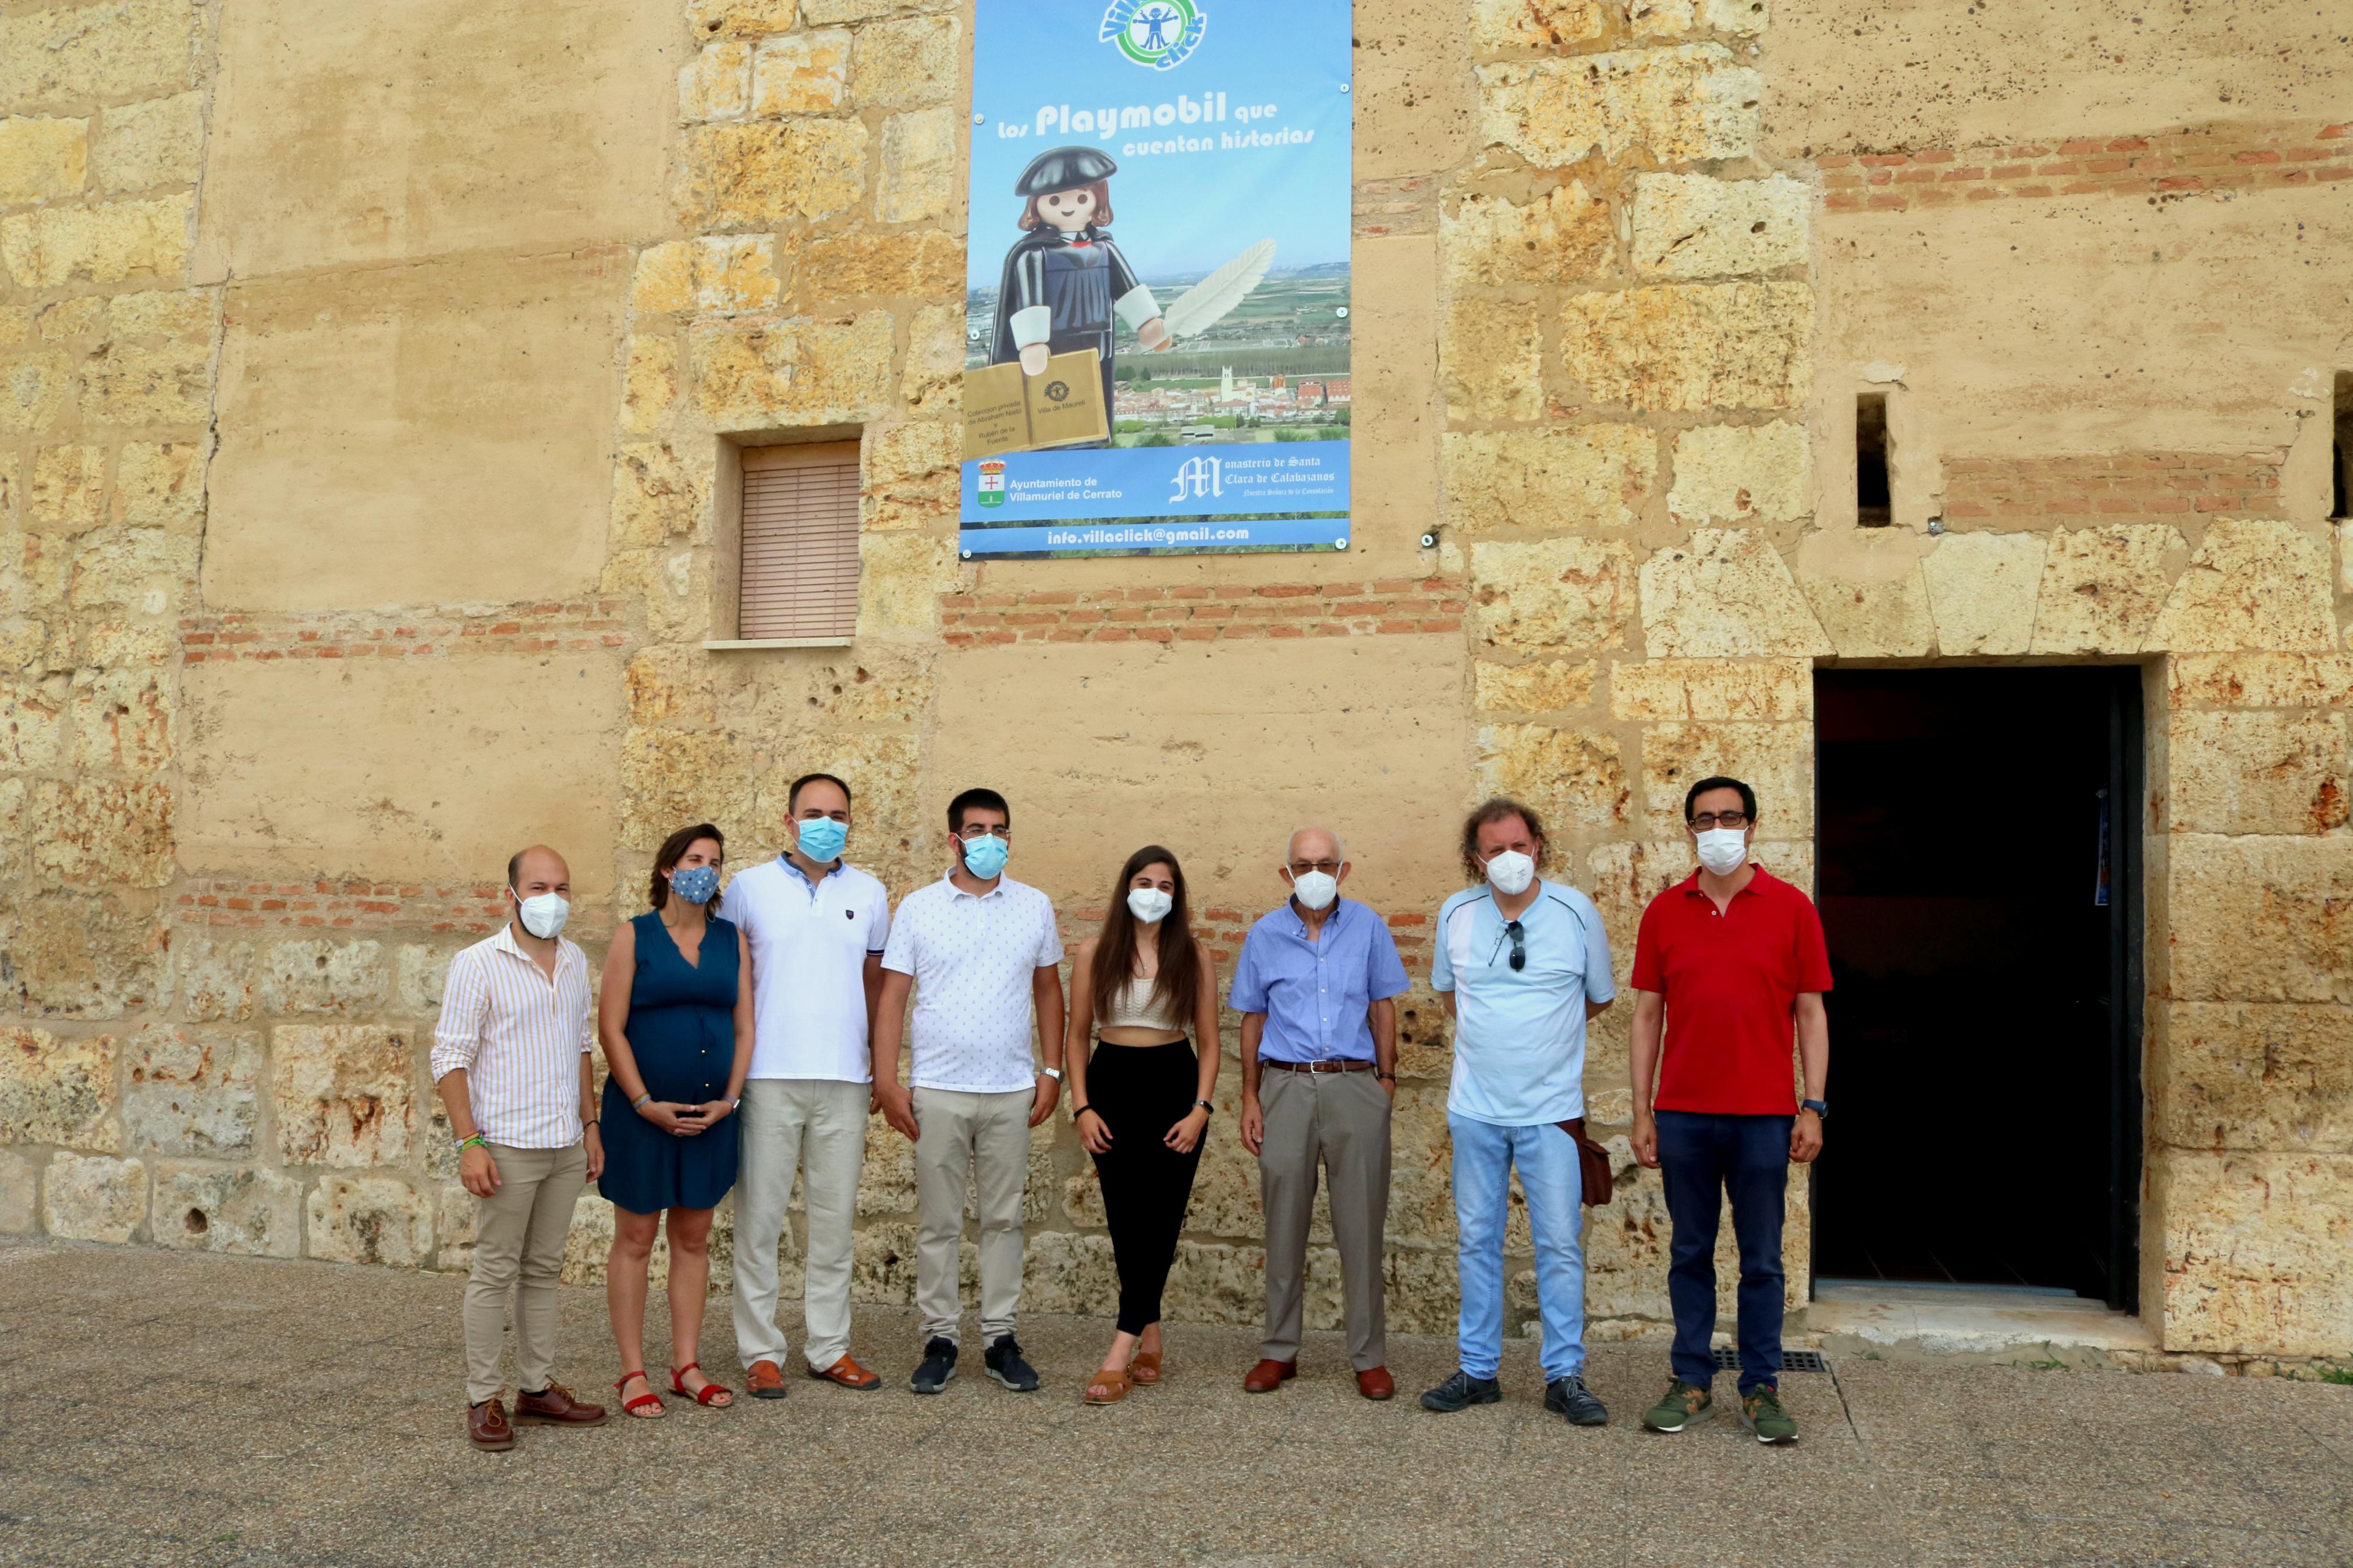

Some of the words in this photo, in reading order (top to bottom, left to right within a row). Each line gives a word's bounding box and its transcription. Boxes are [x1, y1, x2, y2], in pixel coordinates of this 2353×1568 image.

[1102, 0, 1152, 39] Vill
[1156, 16, 1204, 68] click
[1036, 91, 1226, 140] Playmobil
[1234, 104, 1277, 124] que
[1122, 134, 1213, 157] cuentan
[1221, 126, 1315, 150] historias
[998, 401, 1021, 411] privada
[978, 413, 1005, 423] Abraham
[978, 430, 998, 439] Rubén
[987, 436, 1008, 445] Fuente
[1274, 458, 1284, 467] de
[1288, 456, 1321, 467] Santa
[1010, 478, 1081, 491] Ayuntamiento
[1084, 477, 1097, 486] de
[1225, 474, 1253, 484] Clara
[1257, 474, 1268, 483] de
[1271, 472, 1335, 483] Calabazanos
[1010, 490, 1064, 502] Villamuriel
[1067, 491, 1080, 500] de
[1083, 489, 1122, 499] Cerrato
[1048, 527, 1249, 545] info.villaclick@gmail.com
